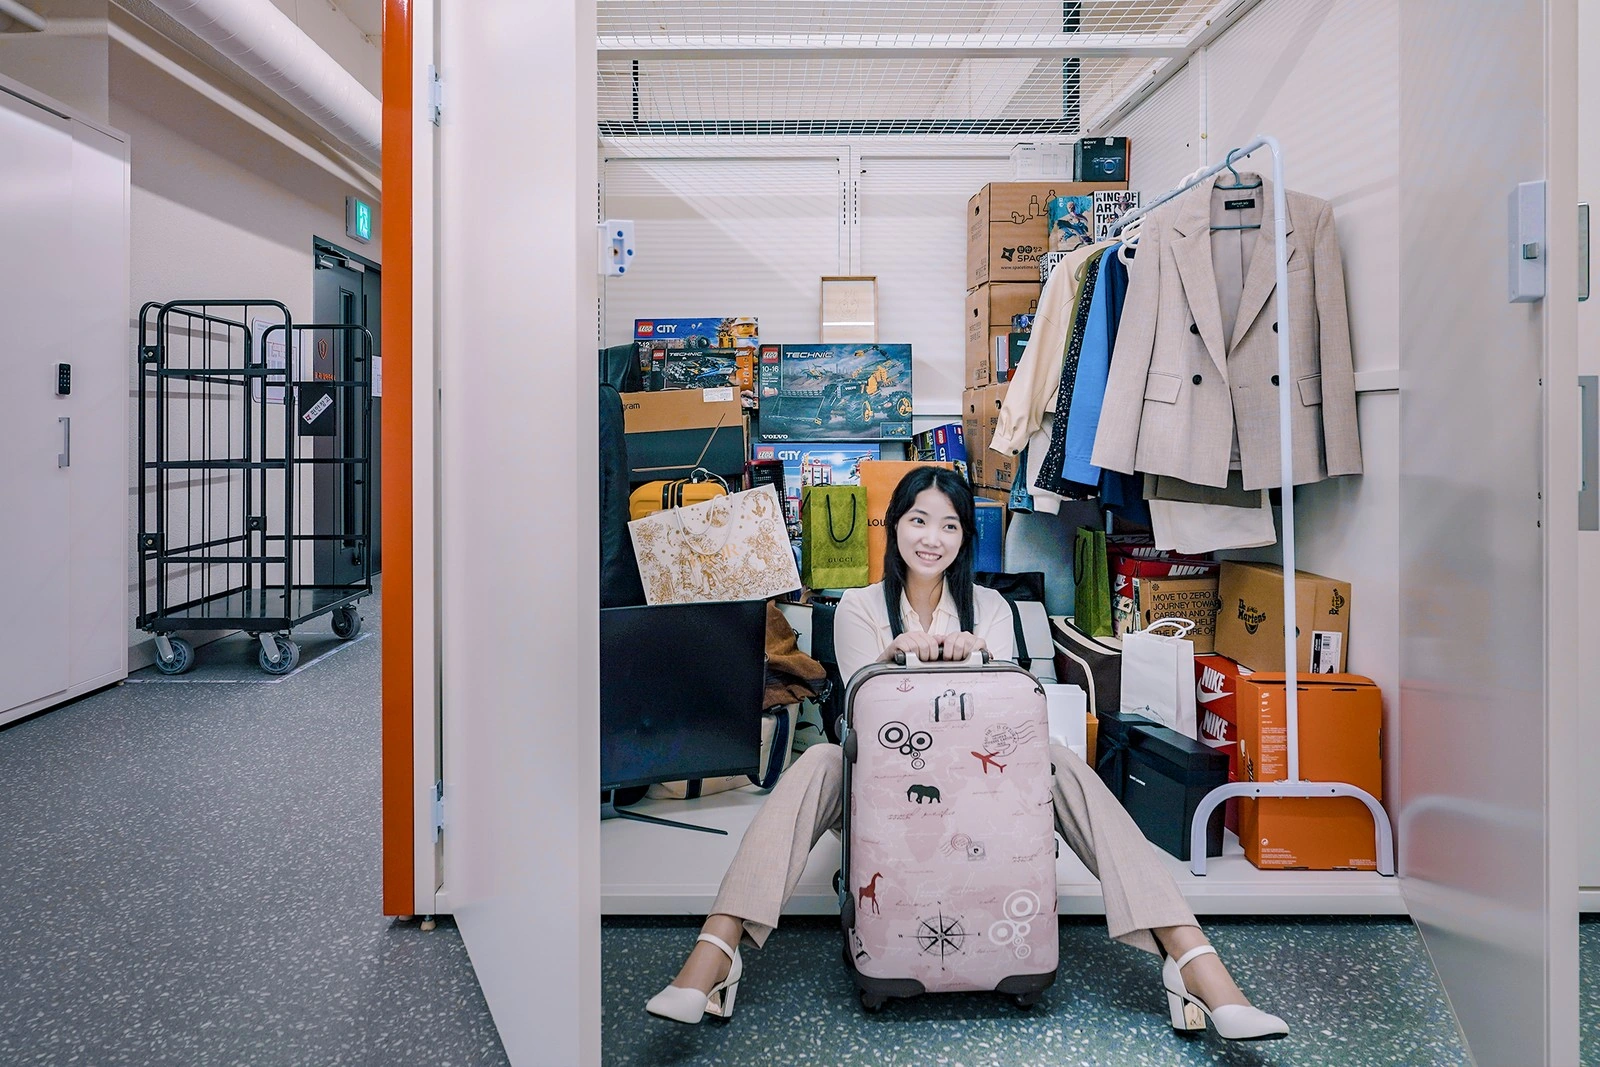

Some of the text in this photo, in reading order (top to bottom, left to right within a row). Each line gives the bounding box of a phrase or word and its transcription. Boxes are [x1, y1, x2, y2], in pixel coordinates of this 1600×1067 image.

[638, 324, 677, 333] LEGO CITY
[763, 351, 778, 359] LEGO
[758, 451, 800, 460] LEGO CITY
[1153, 594, 1175, 602] MOVE
[1153, 602, 1190, 610] JOURNEY
[1154, 611, 1187, 620] CARBON
[1238, 609, 1266, 624] Martens
[1202, 666, 1226, 693] NIKE
[1203, 709, 1228, 741] NIKE
